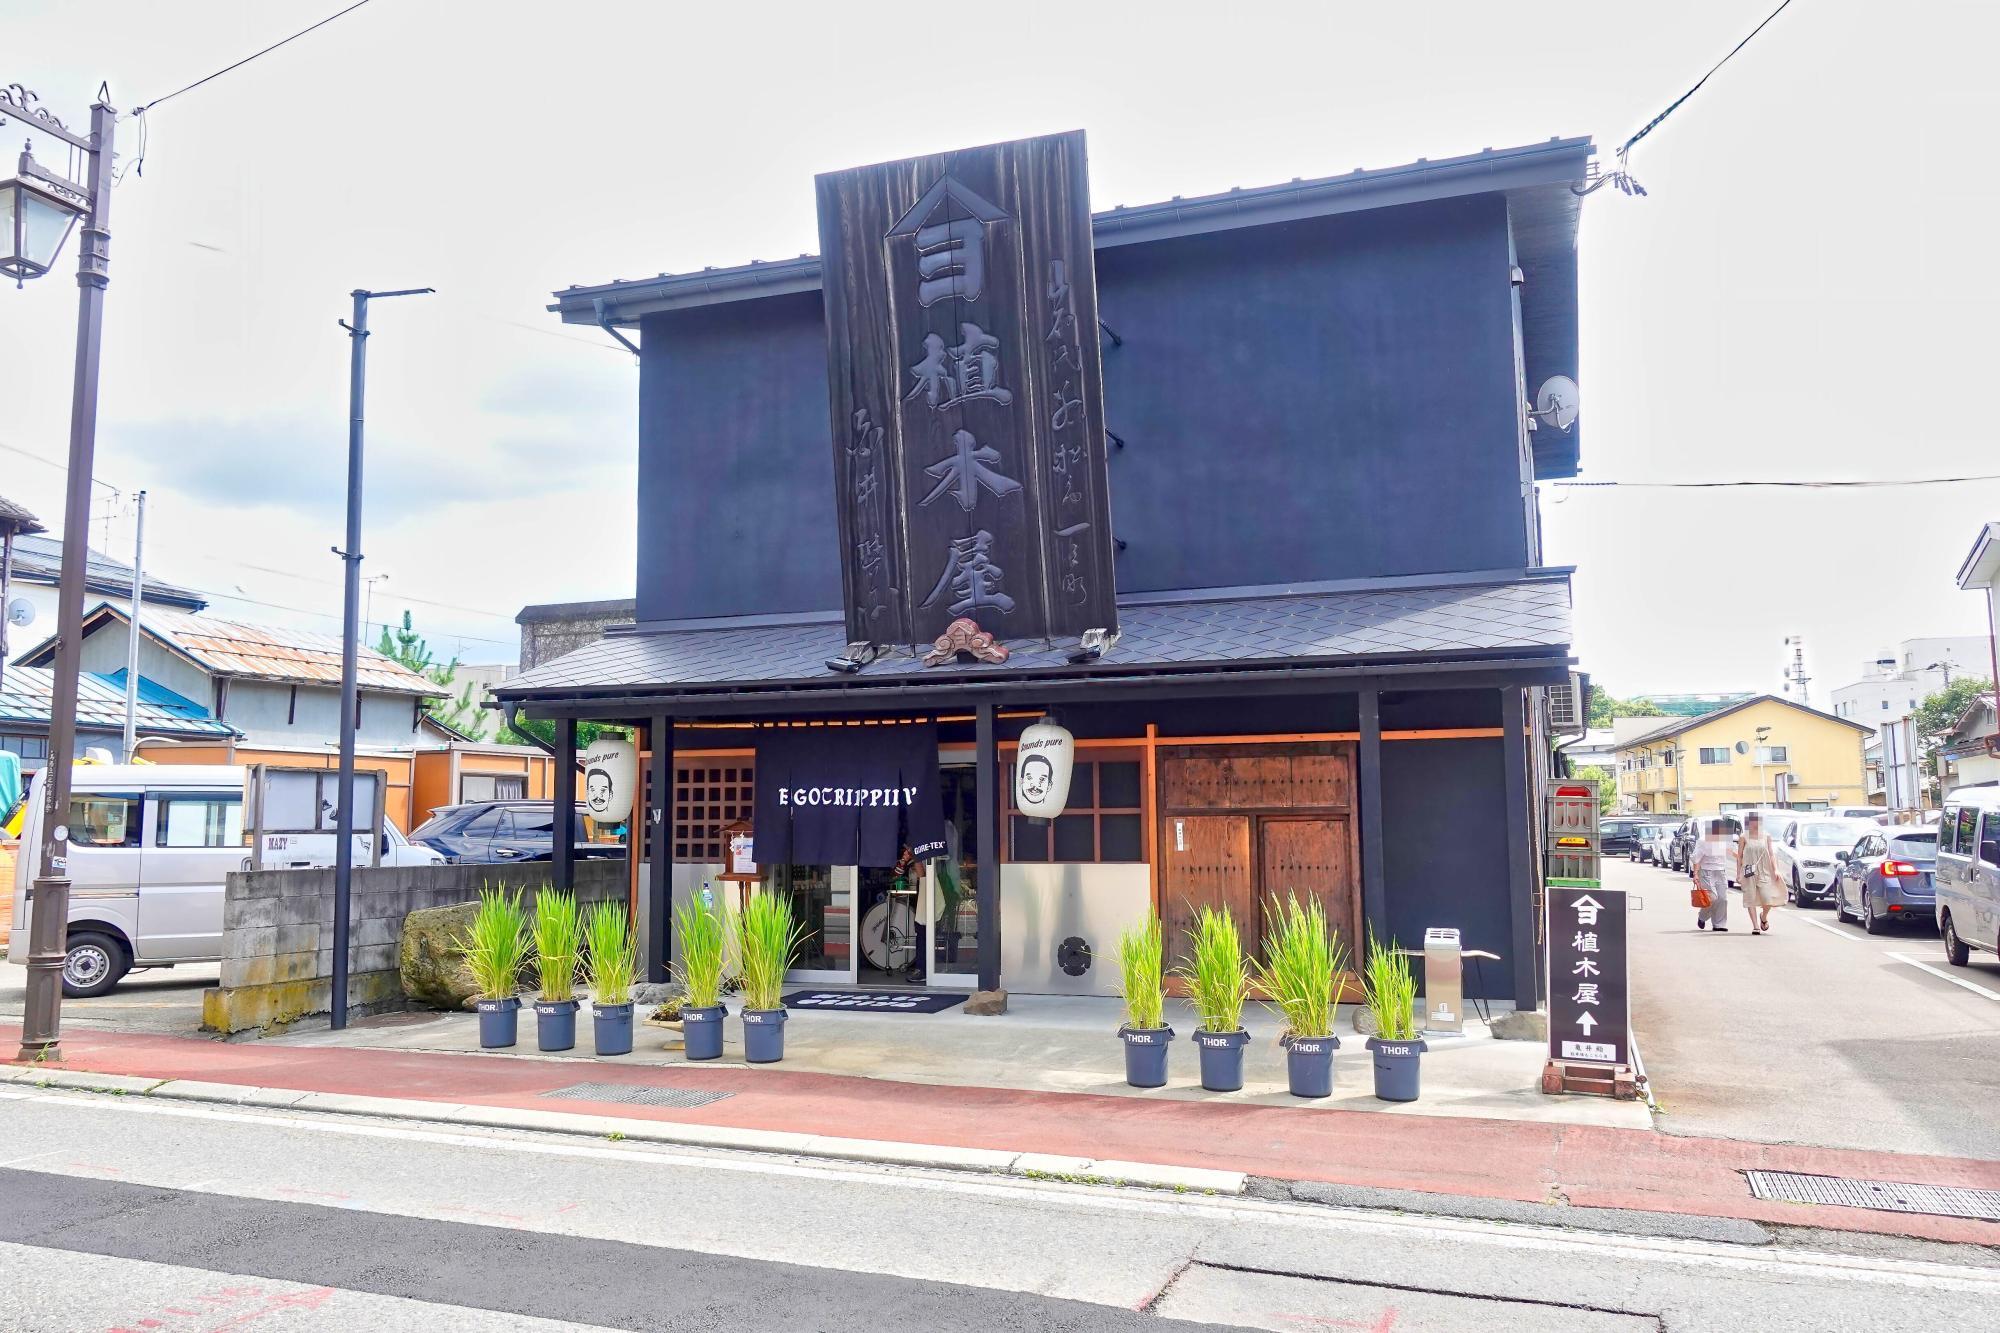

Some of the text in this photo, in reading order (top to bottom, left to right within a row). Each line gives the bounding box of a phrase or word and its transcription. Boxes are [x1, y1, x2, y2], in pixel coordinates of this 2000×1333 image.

[900, 322, 1024, 616] 植木屋
[1044, 738, 1063, 749] pure
[602, 751, 620, 763] pure
[1571, 930, 1601, 1006] 植木屋
[1127, 1033, 1154, 1043] THOR.
[1202, 1037, 1230, 1047] THOR.
[1294, 1043, 1322, 1052] THOR.
[1381, 1045, 1412, 1055] THOR.
